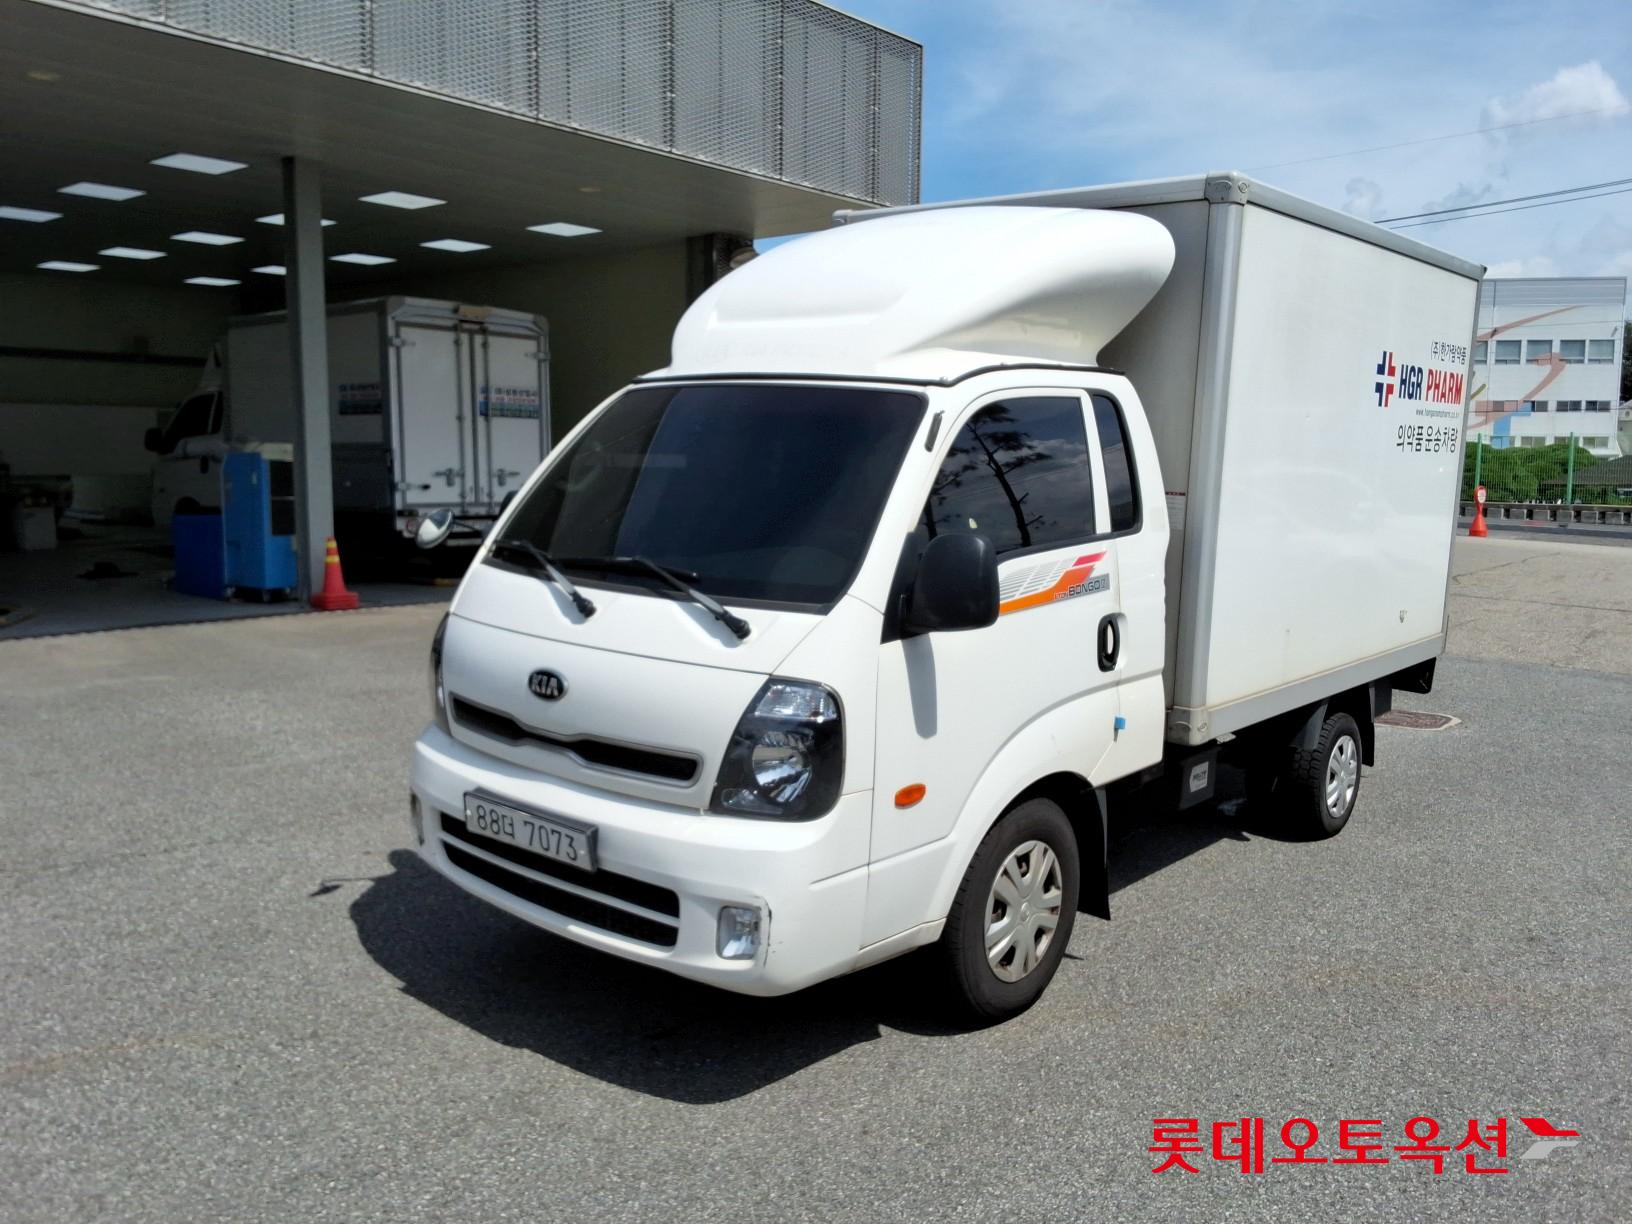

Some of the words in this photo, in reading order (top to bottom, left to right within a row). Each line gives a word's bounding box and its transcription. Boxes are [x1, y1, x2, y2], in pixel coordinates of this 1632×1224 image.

[1398, 364, 1424, 401] HGR
[1425, 368, 1464, 405] PHARM
[531, 672, 560, 697] KIA
[523, 820, 577, 861] 7073
